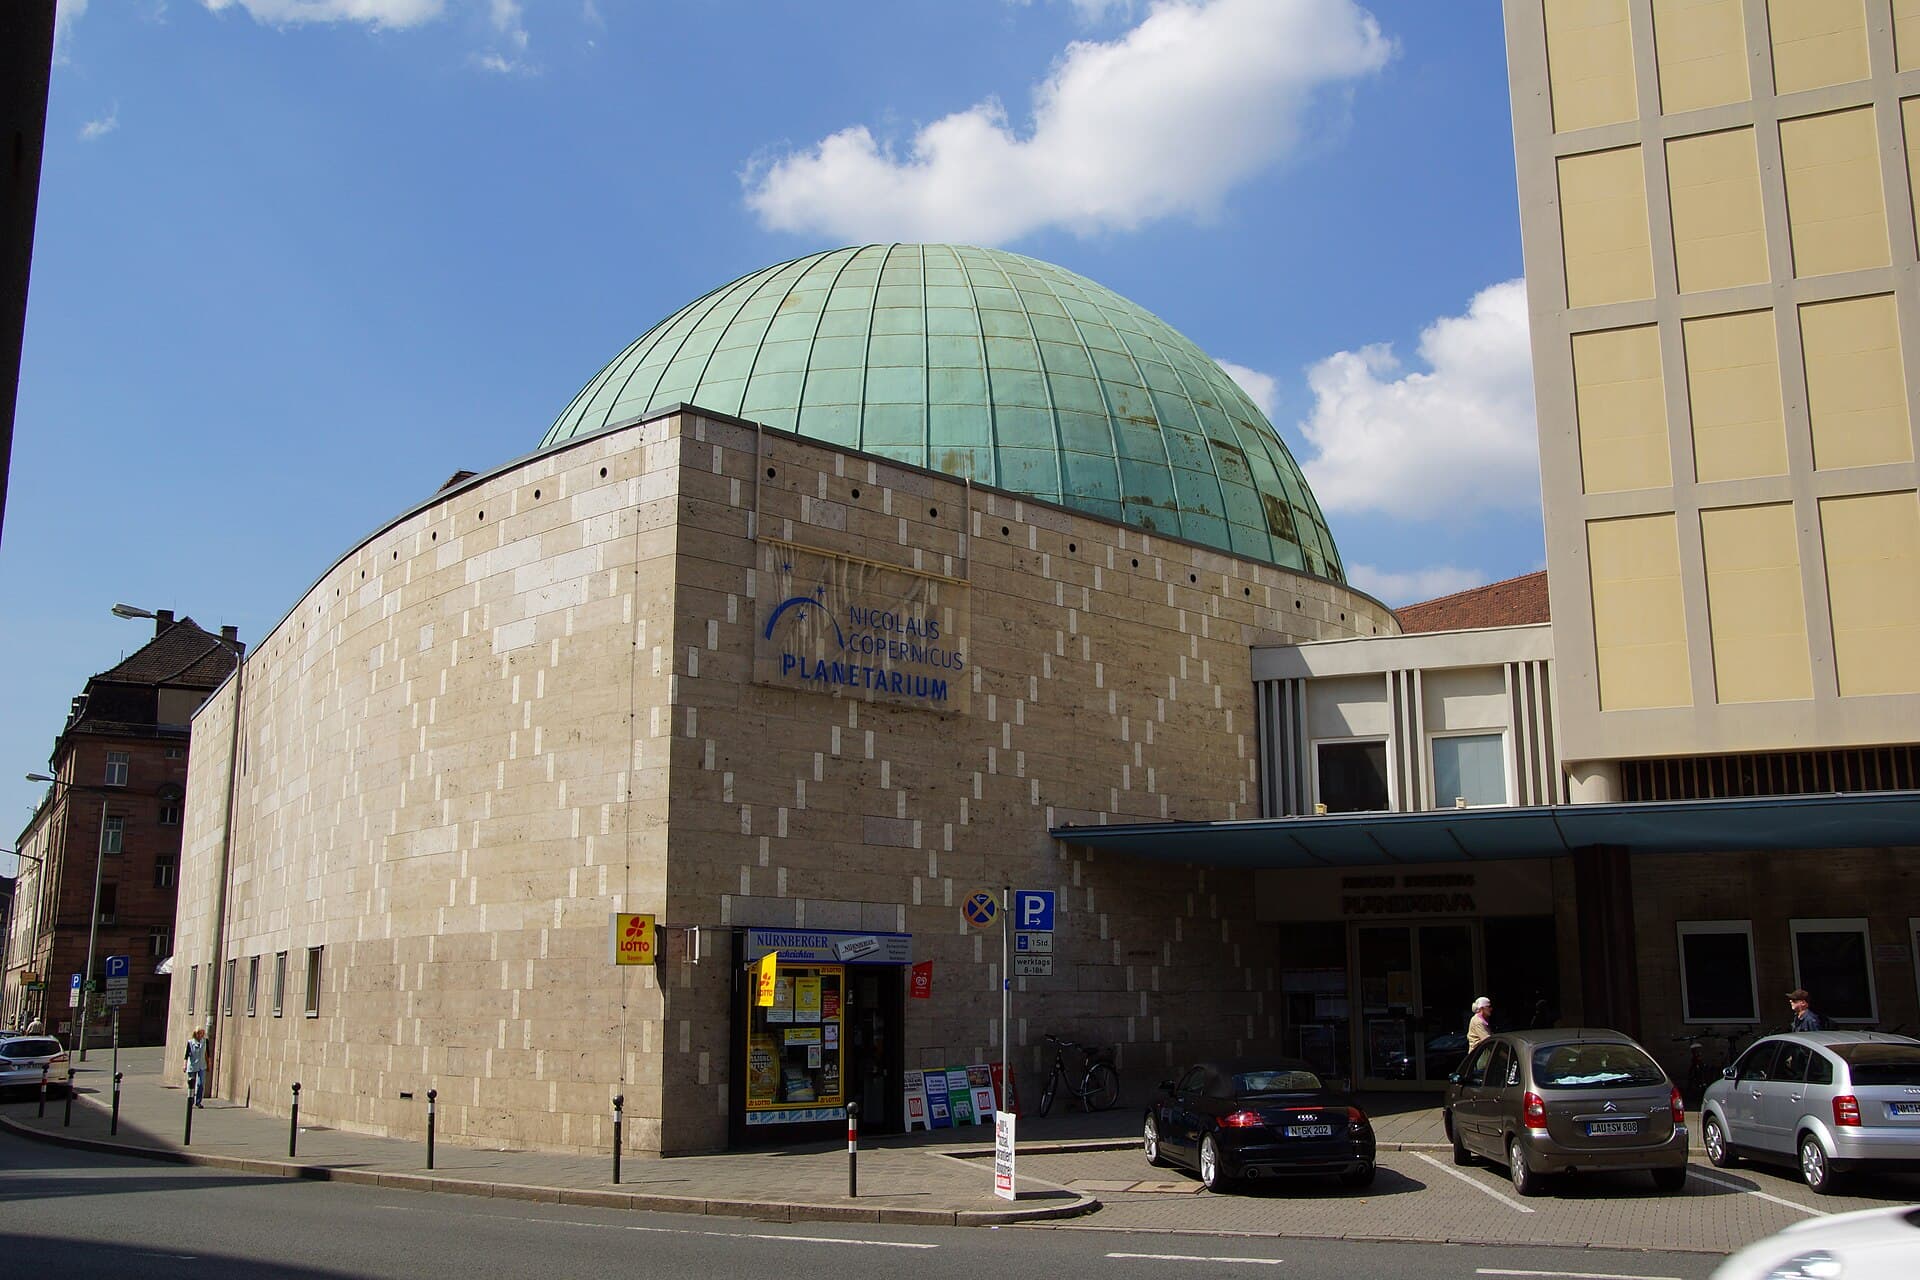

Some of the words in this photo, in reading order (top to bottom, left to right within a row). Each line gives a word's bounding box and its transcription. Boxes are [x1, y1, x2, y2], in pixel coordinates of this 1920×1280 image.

[850, 606, 940, 640] NICOLAUS
[849, 633, 963, 670] COPERNICUS
[783, 653, 948, 701] PLANETARIUM
[1024, 895, 1046, 925] P
[620, 941, 650, 952] LOTTO
[757, 933, 829, 949] NÜRNBERGER
[112, 959, 124, 975] P
[1017, 958, 1050, 967] werktags
[73, 976, 80, 987] P
[1291, 1127, 1298, 1135] N
[1313, 1125, 1329, 1135] 202
[1623, 1121, 1638, 1132] 808
